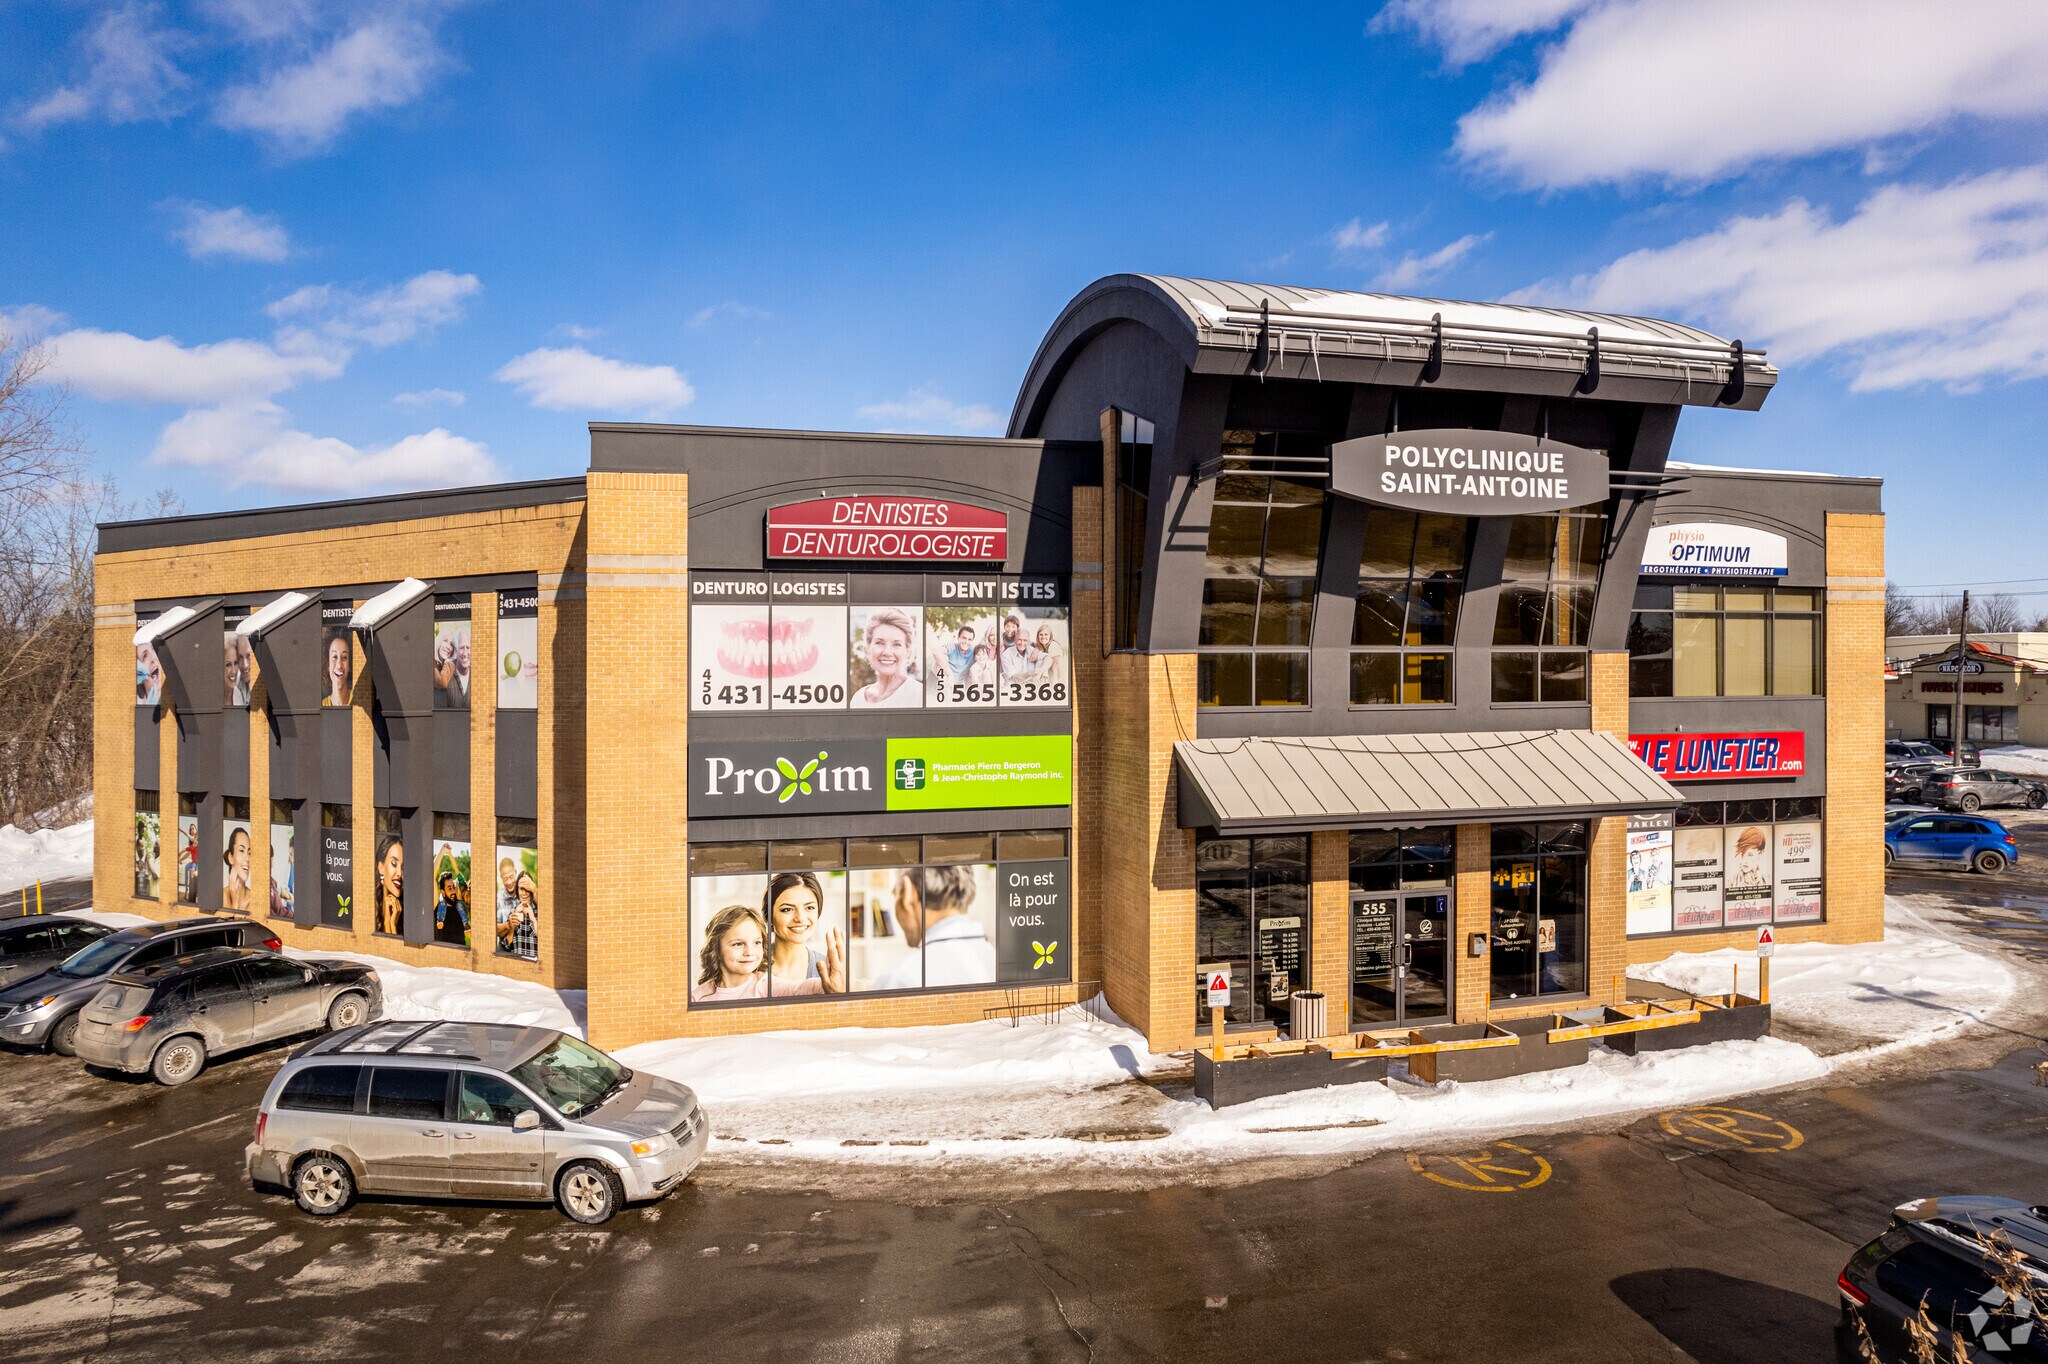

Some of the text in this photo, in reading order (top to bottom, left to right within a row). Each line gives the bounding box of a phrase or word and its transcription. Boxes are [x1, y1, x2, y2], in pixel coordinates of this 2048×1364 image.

[1386, 446, 1564, 472] POLYCLINIQUE
[1381, 472, 1568, 498] SAINT-ANTOINE
[832, 502, 948, 526] DENTISTES
[782, 532, 994, 556] DENTUROLOGISTE
[1669, 530, 1704, 544] physio
[1672, 544, 1750, 562] OPTIMUM
[1644, 565, 1774, 576] ERGOTHÉRAPIE PHYSIOTHÉRAPIE
[1675, 738, 1780, 773] LUNETIER
[1780, 760, 1802, 770] .com
[1004, 762, 1040, 771] Bergeron
[705, 751, 872, 803] Proxim
[942, 773, 1007, 782] Jean-Christophe
[1010, 772, 1048, 781] Raymond
[326, 838, 348, 850] On est
[326, 854, 350, 867] là pour
[326, 872, 344, 882] vous.
[1009, 873, 1054, 888] On est
[1009, 893, 1057, 910] là pour
[1363, 903, 1386, 915] 555
[1009, 914, 1044, 927] vous.
